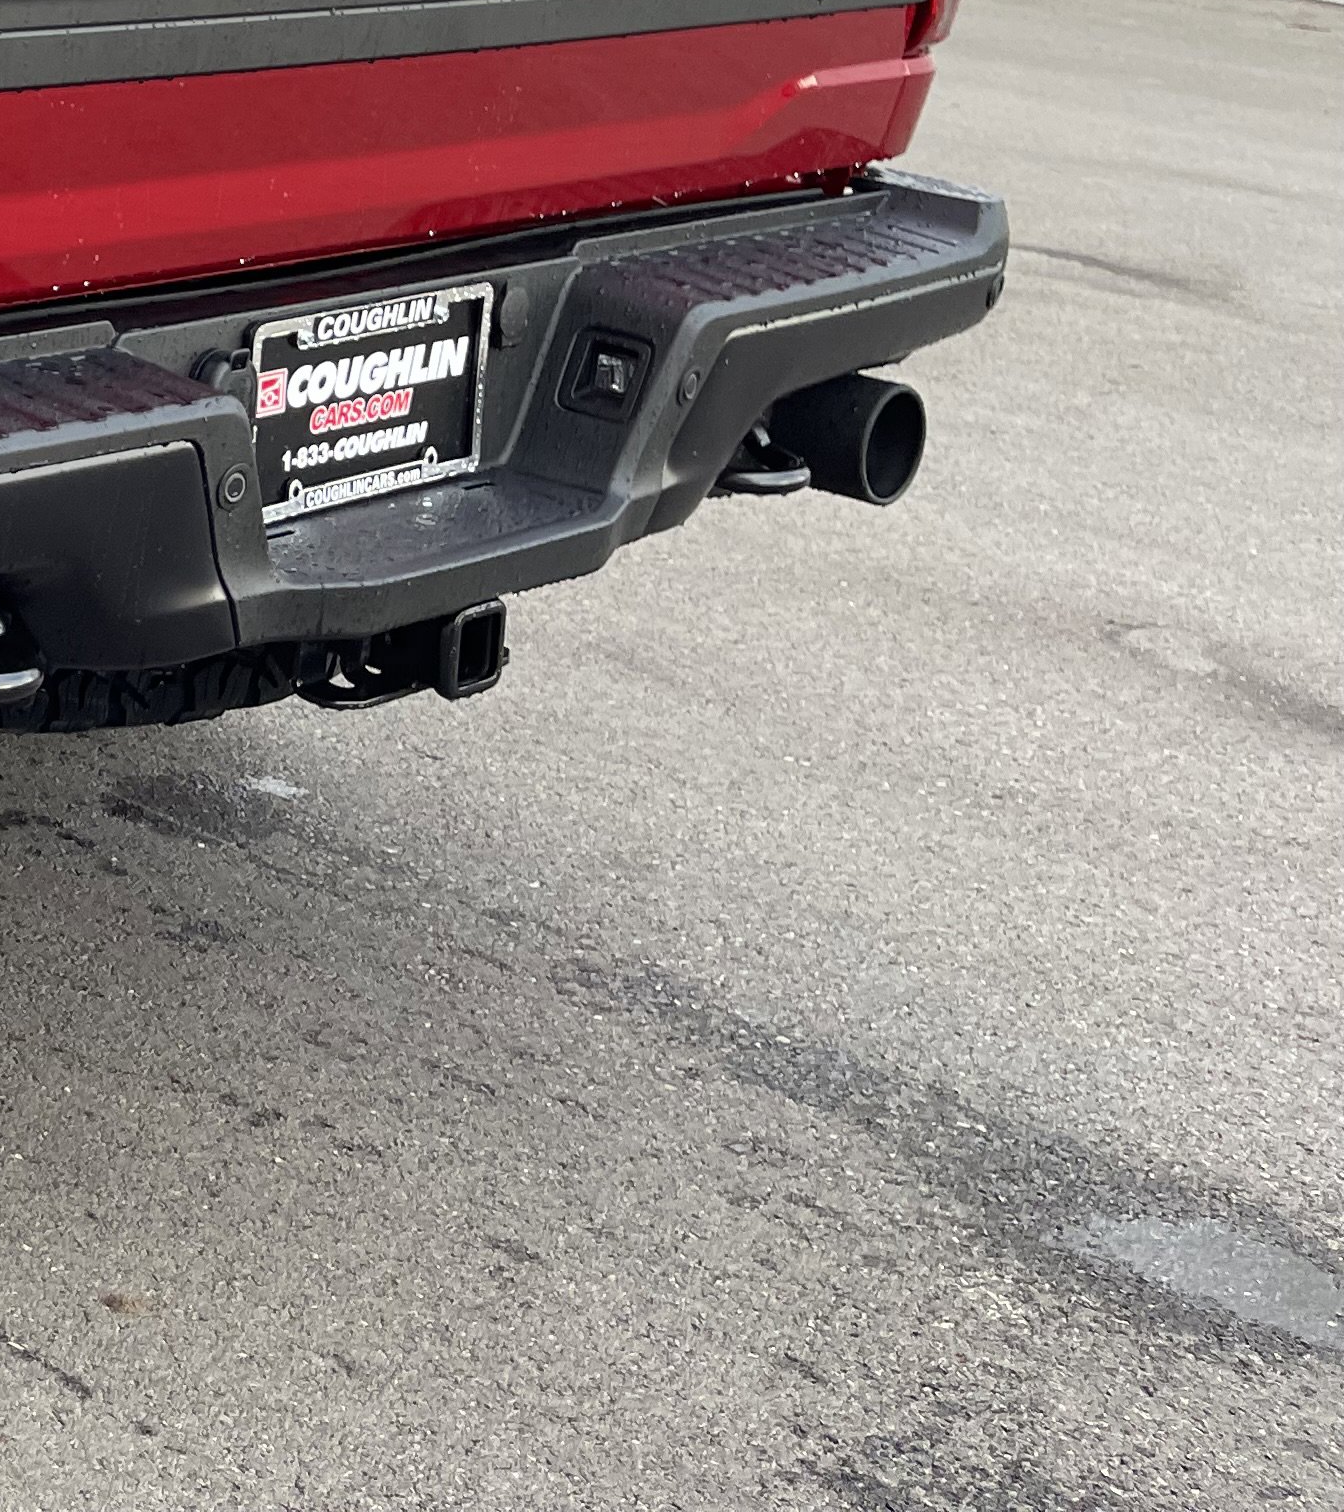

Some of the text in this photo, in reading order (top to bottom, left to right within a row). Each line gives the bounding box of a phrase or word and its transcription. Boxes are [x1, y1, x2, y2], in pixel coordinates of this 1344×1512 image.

[317, 296, 434, 340] COUGHLIN
[286, 336, 470, 407] COUGHLIN
[310, 388, 413, 434] CARS.COM
[282, 421, 429, 472] 1-833-COUGHLIN
[305, 467, 421, 509] COUGHLINCARS.com
